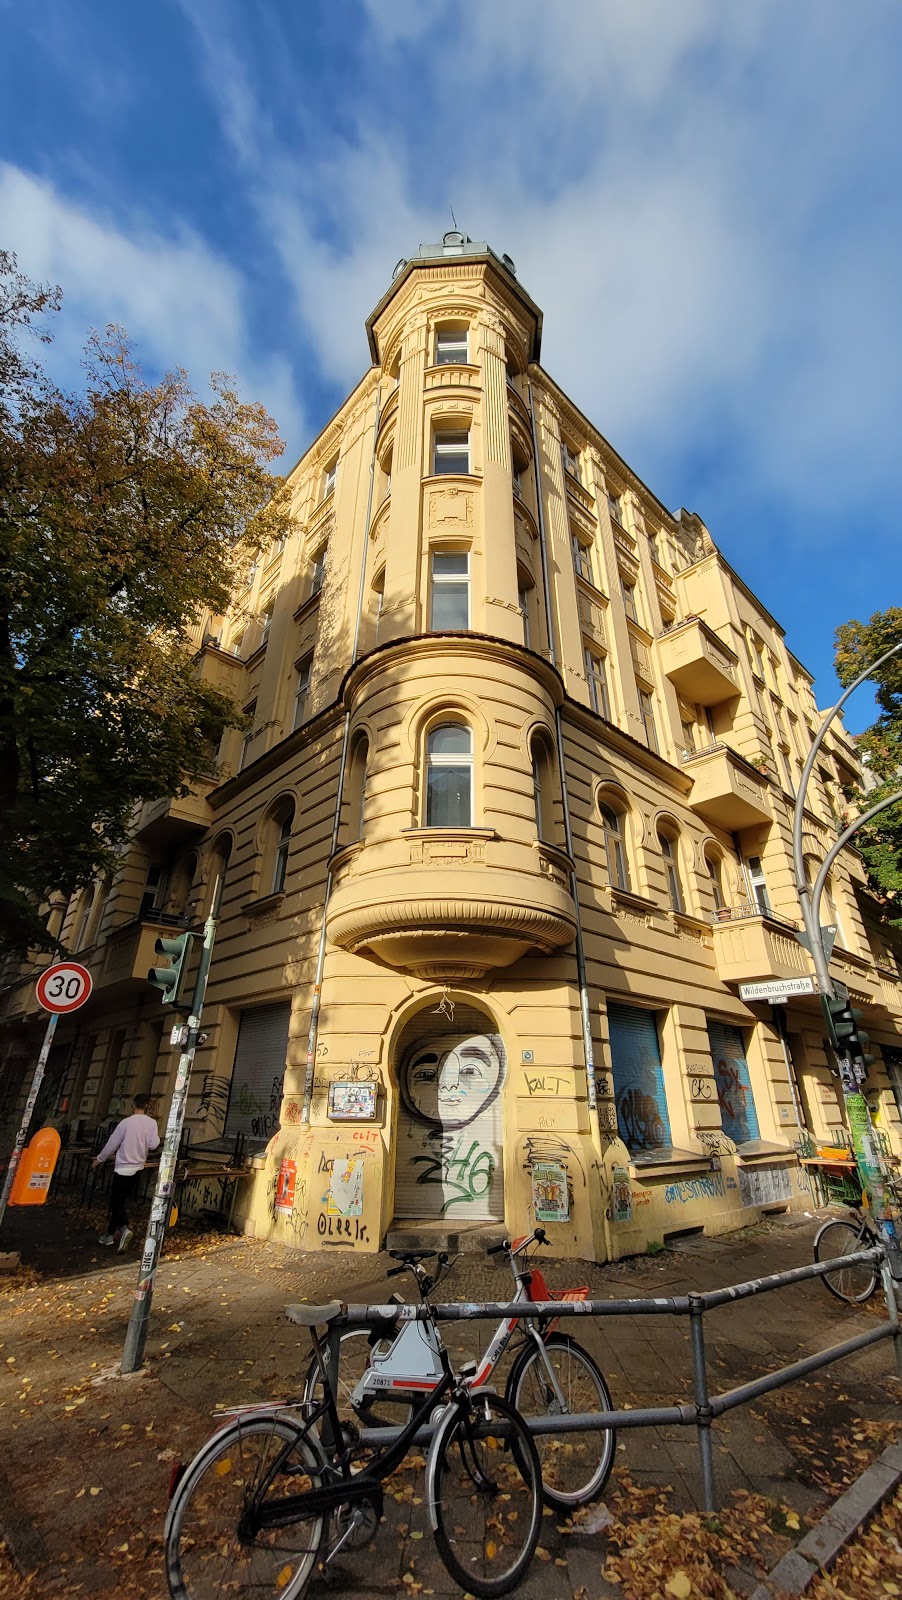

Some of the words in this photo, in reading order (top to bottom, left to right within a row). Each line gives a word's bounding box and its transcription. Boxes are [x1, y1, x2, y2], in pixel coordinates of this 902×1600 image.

[48, 975, 81, 999] 30
[742, 981, 811, 996] Wildenbruchstraße
[490, 1350, 500, 1362] Call
[500, 1332, 510, 1347] Bike
[372, 1378, 391, 1387] 20871
